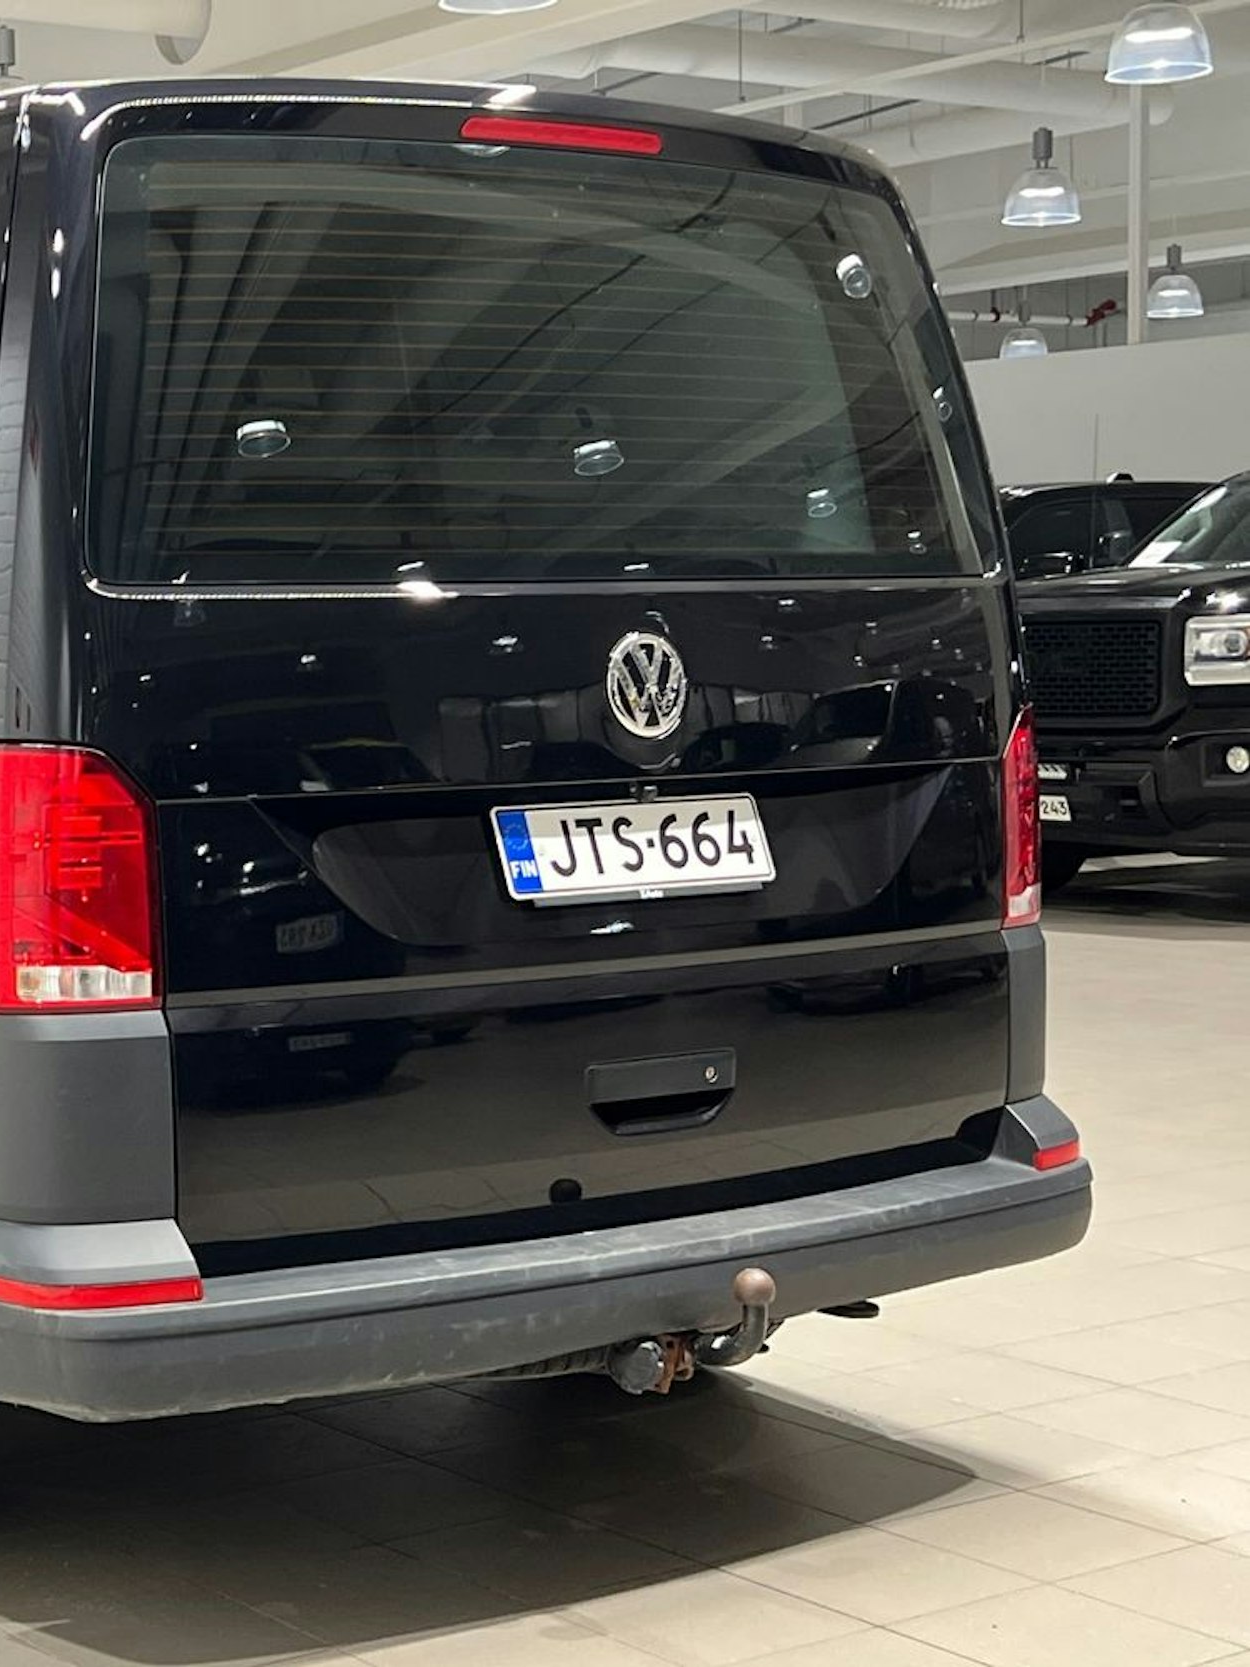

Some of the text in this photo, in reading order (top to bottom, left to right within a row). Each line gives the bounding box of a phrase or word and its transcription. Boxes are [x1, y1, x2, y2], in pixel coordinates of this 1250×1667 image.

[1041, 801, 1067, 815] 243
[550, 810, 754, 877] JTS-664
[510, 860, 538, 879] FIN
